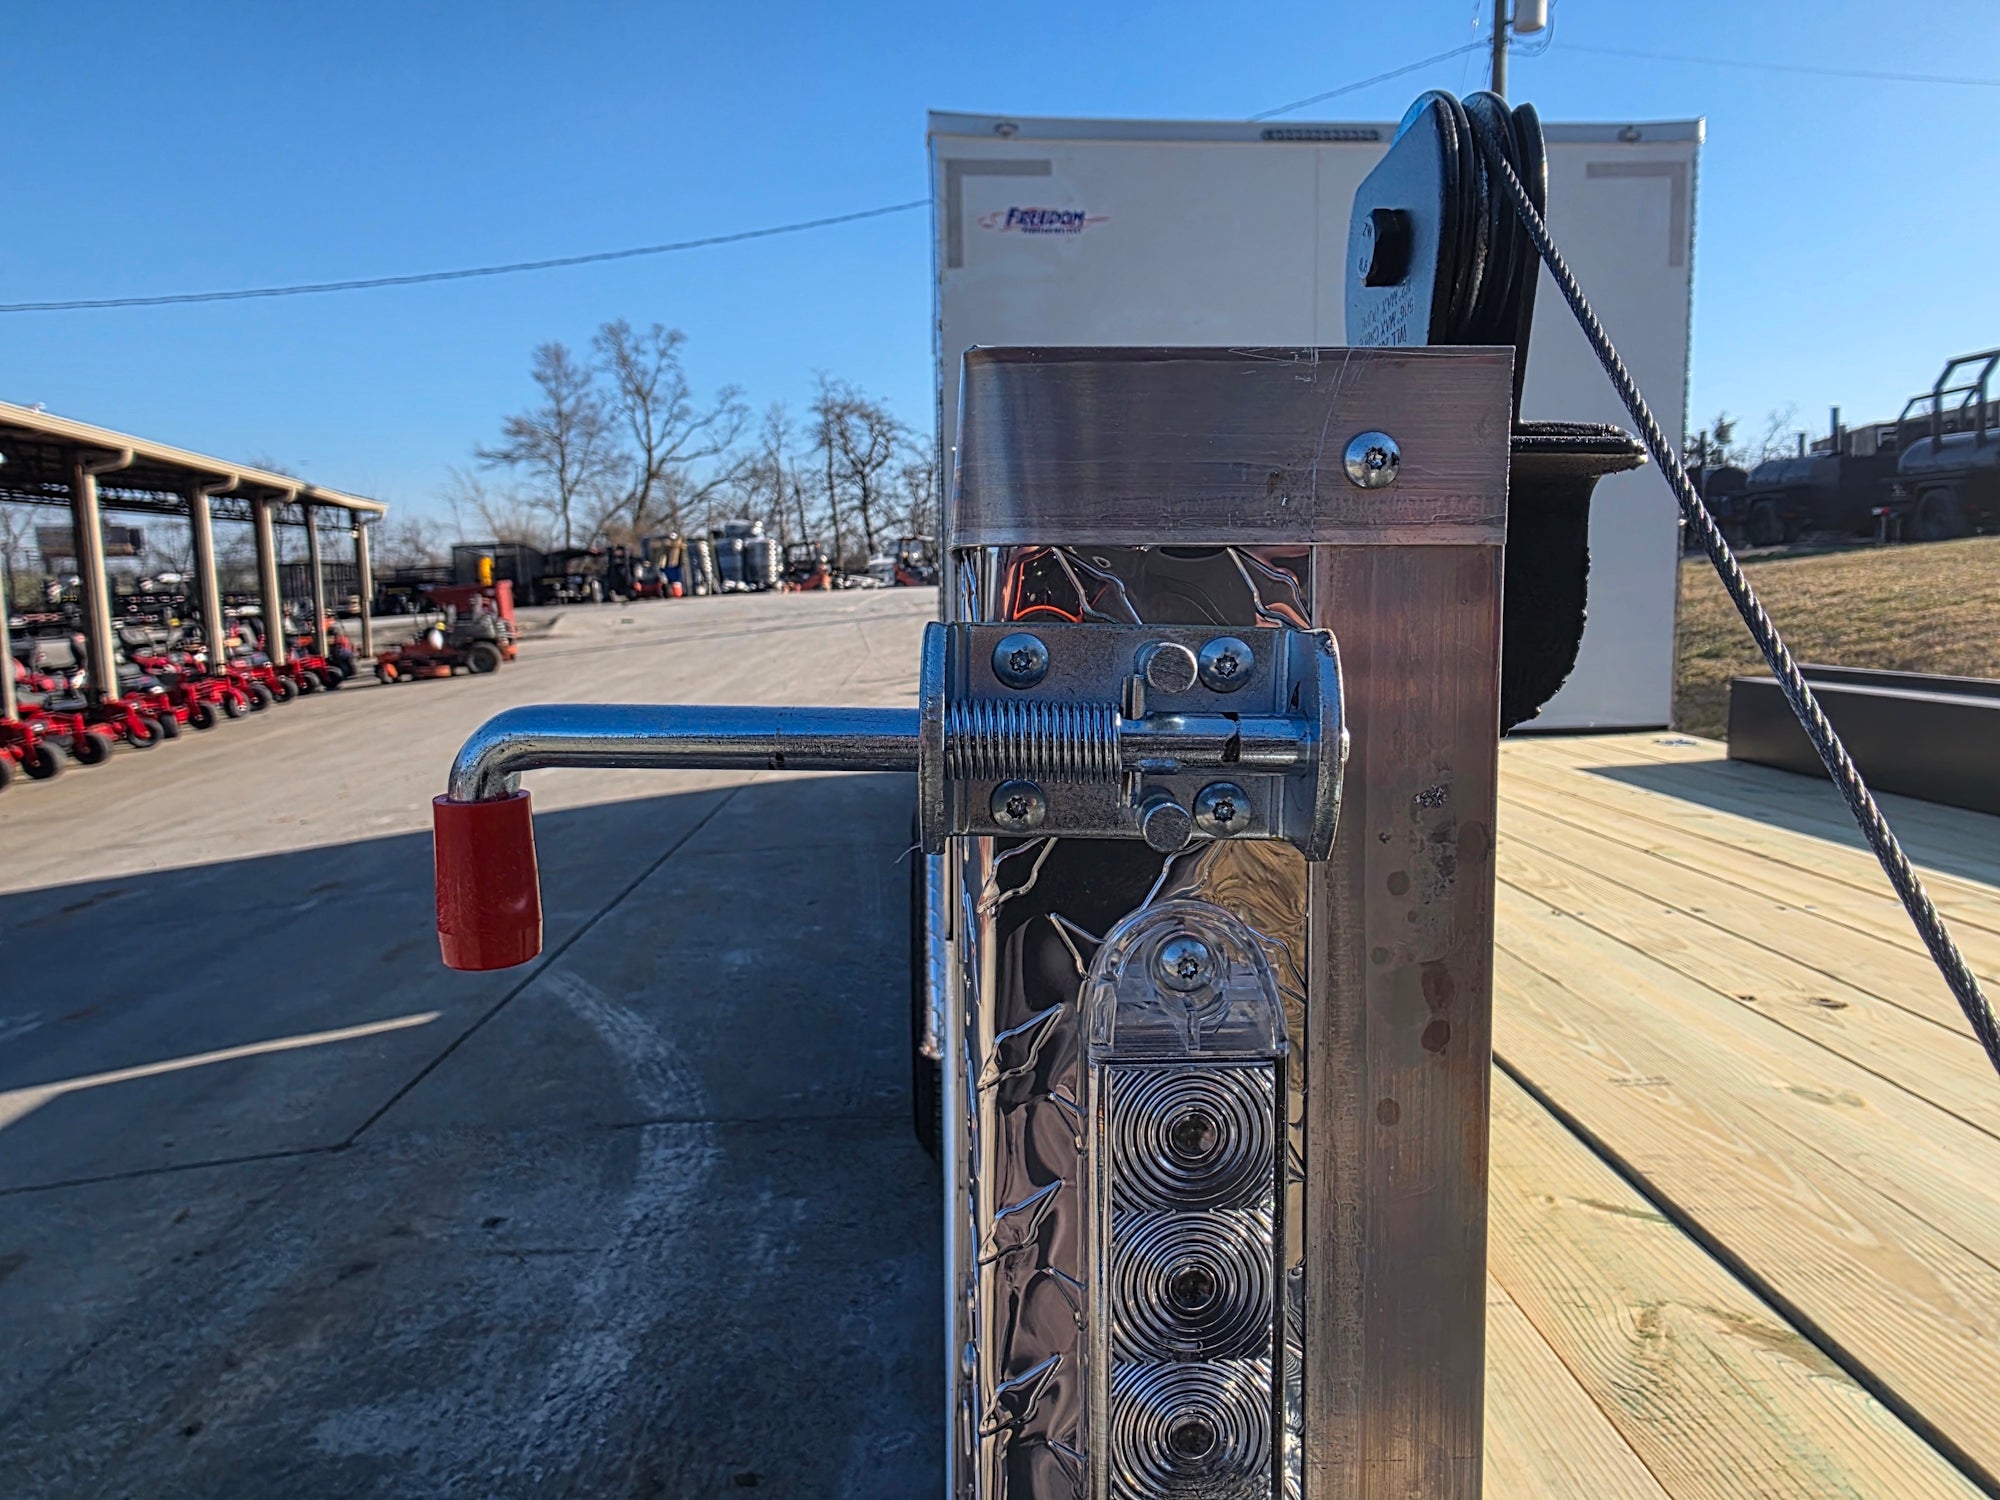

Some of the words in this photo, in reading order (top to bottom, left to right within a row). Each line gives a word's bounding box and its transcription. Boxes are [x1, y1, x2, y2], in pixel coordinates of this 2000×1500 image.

[1006, 207, 1086, 227] FREEDOM
[1382, 289, 1398, 315] MAX
[1381, 311, 1396, 337] MAX
